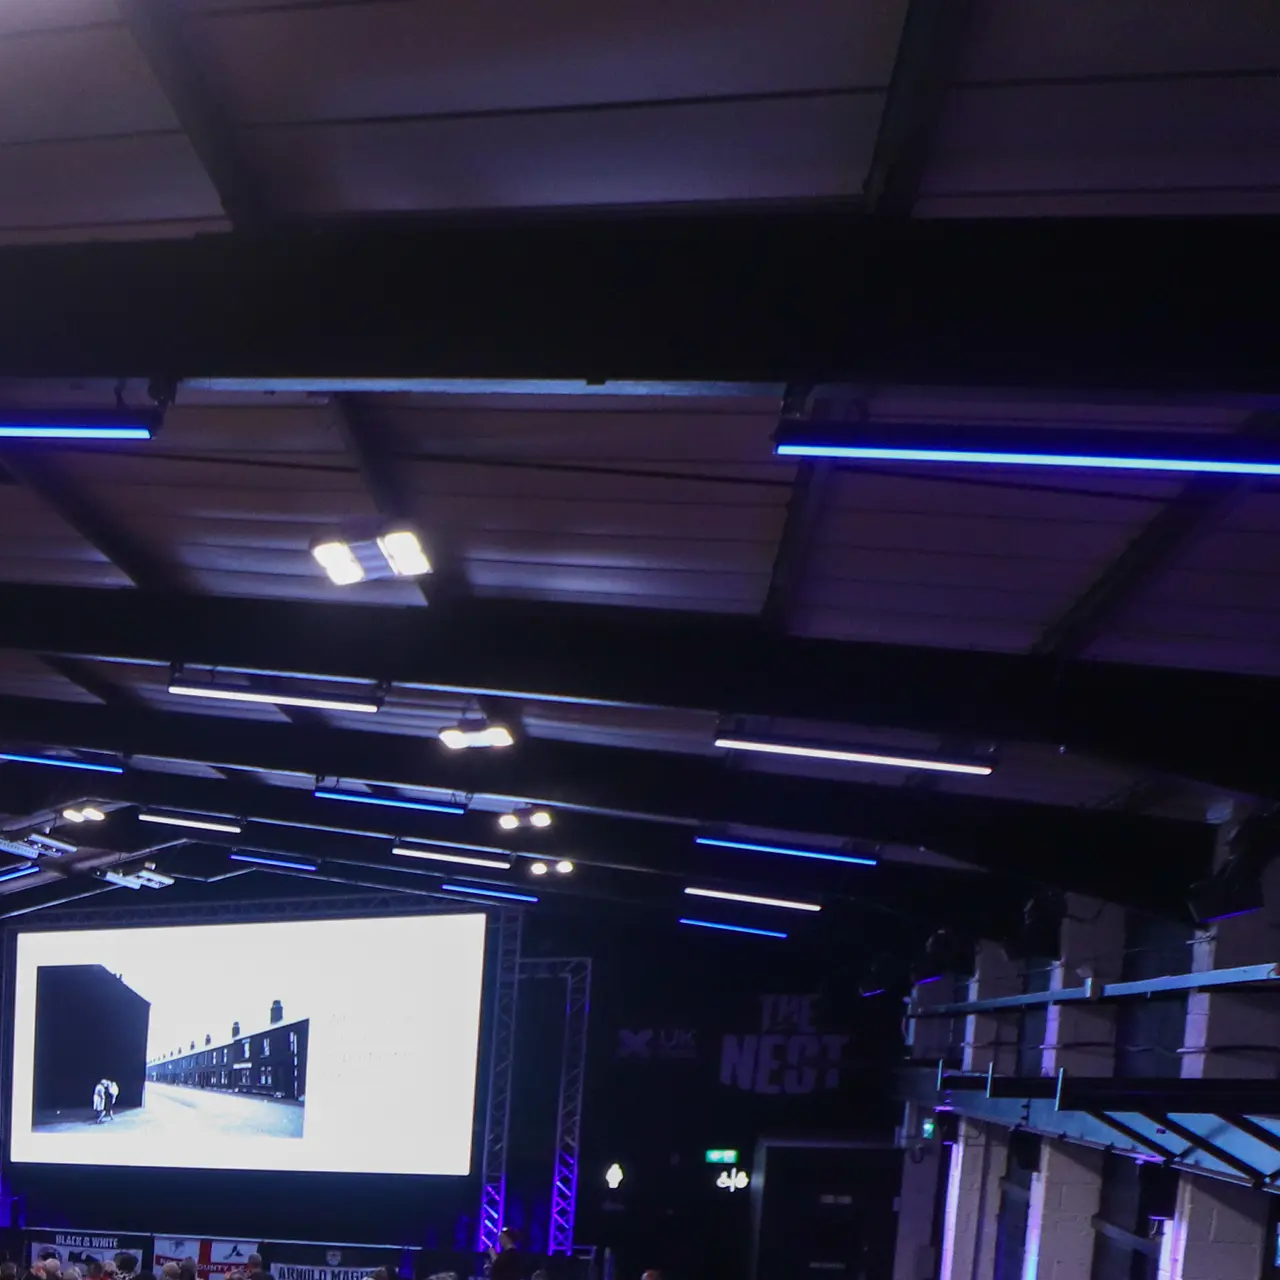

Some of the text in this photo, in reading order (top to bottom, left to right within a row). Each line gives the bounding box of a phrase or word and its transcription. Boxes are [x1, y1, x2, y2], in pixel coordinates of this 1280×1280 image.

[55, 1234, 118, 1248] BLACK & WHITE
[196, 1263, 228, 1273] OUNTY
